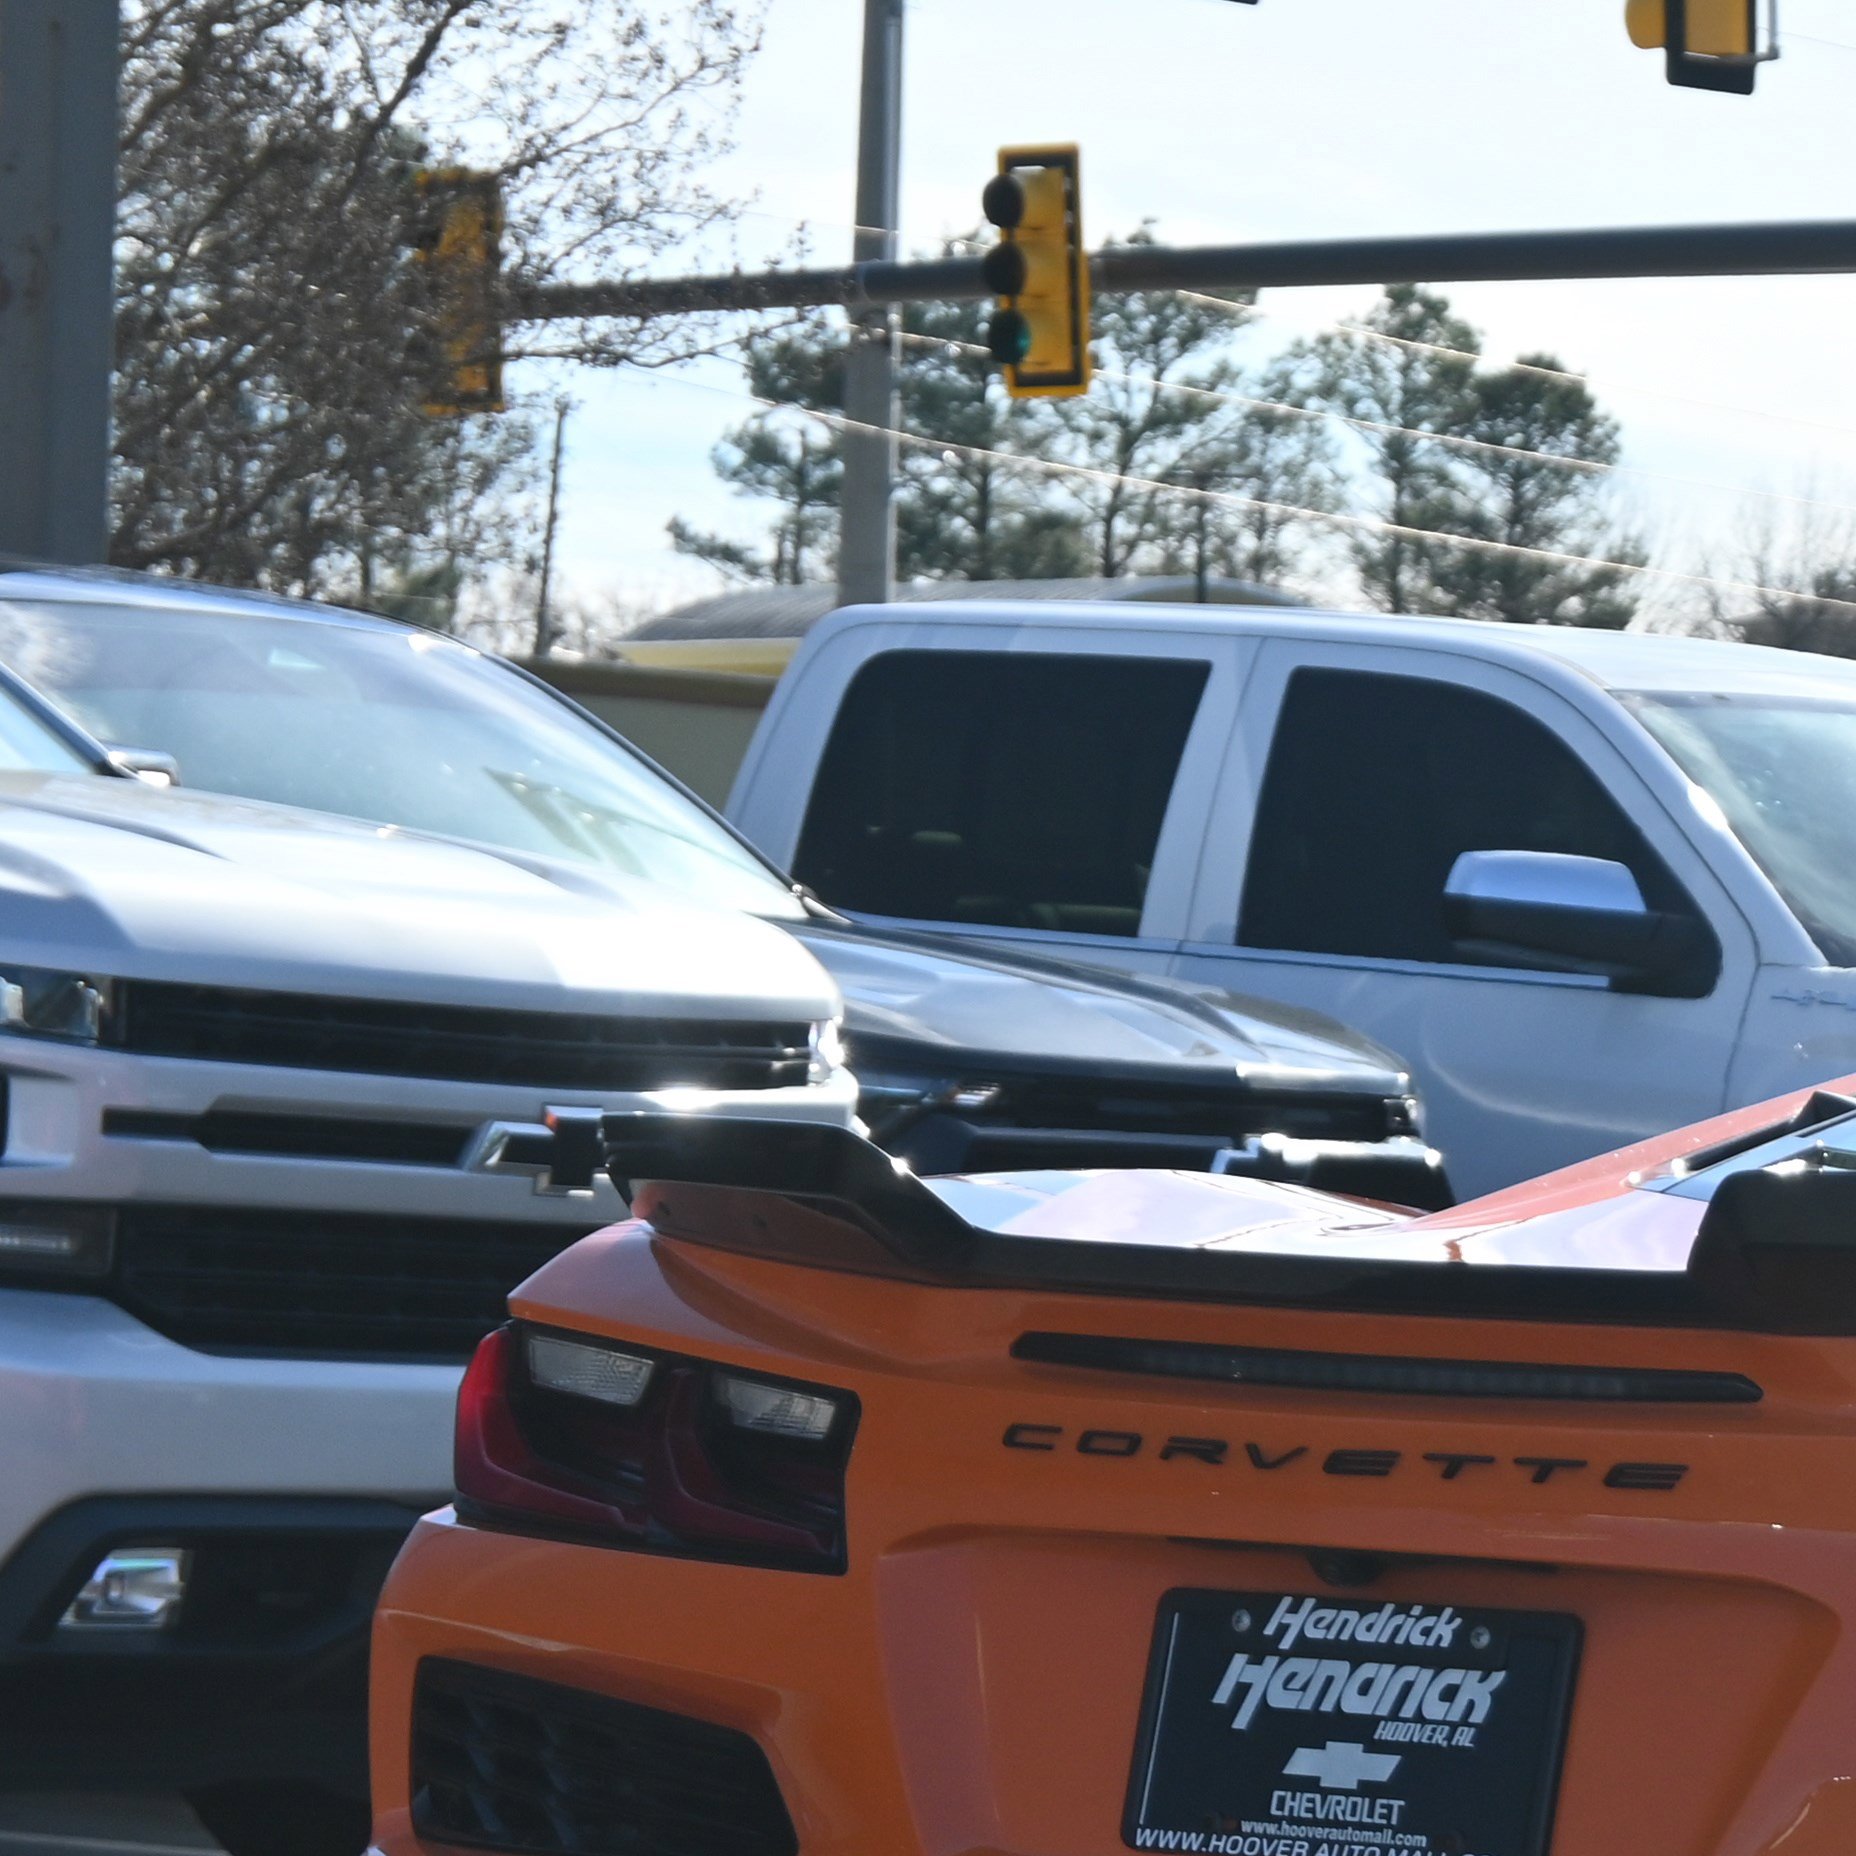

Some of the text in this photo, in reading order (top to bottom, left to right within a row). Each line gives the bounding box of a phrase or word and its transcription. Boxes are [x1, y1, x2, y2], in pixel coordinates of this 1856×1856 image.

[1001, 1422, 1690, 1490] CORVETTE
[1262, 1596, 1462, 1650] Hendrick
[1373, 1720, 1476, 1748] HOOVER, AL
[1269, 1790, 1405, 1826] CHEVROLET
[1240, 1818, 1428, 1848] www.hooverautomall.com
